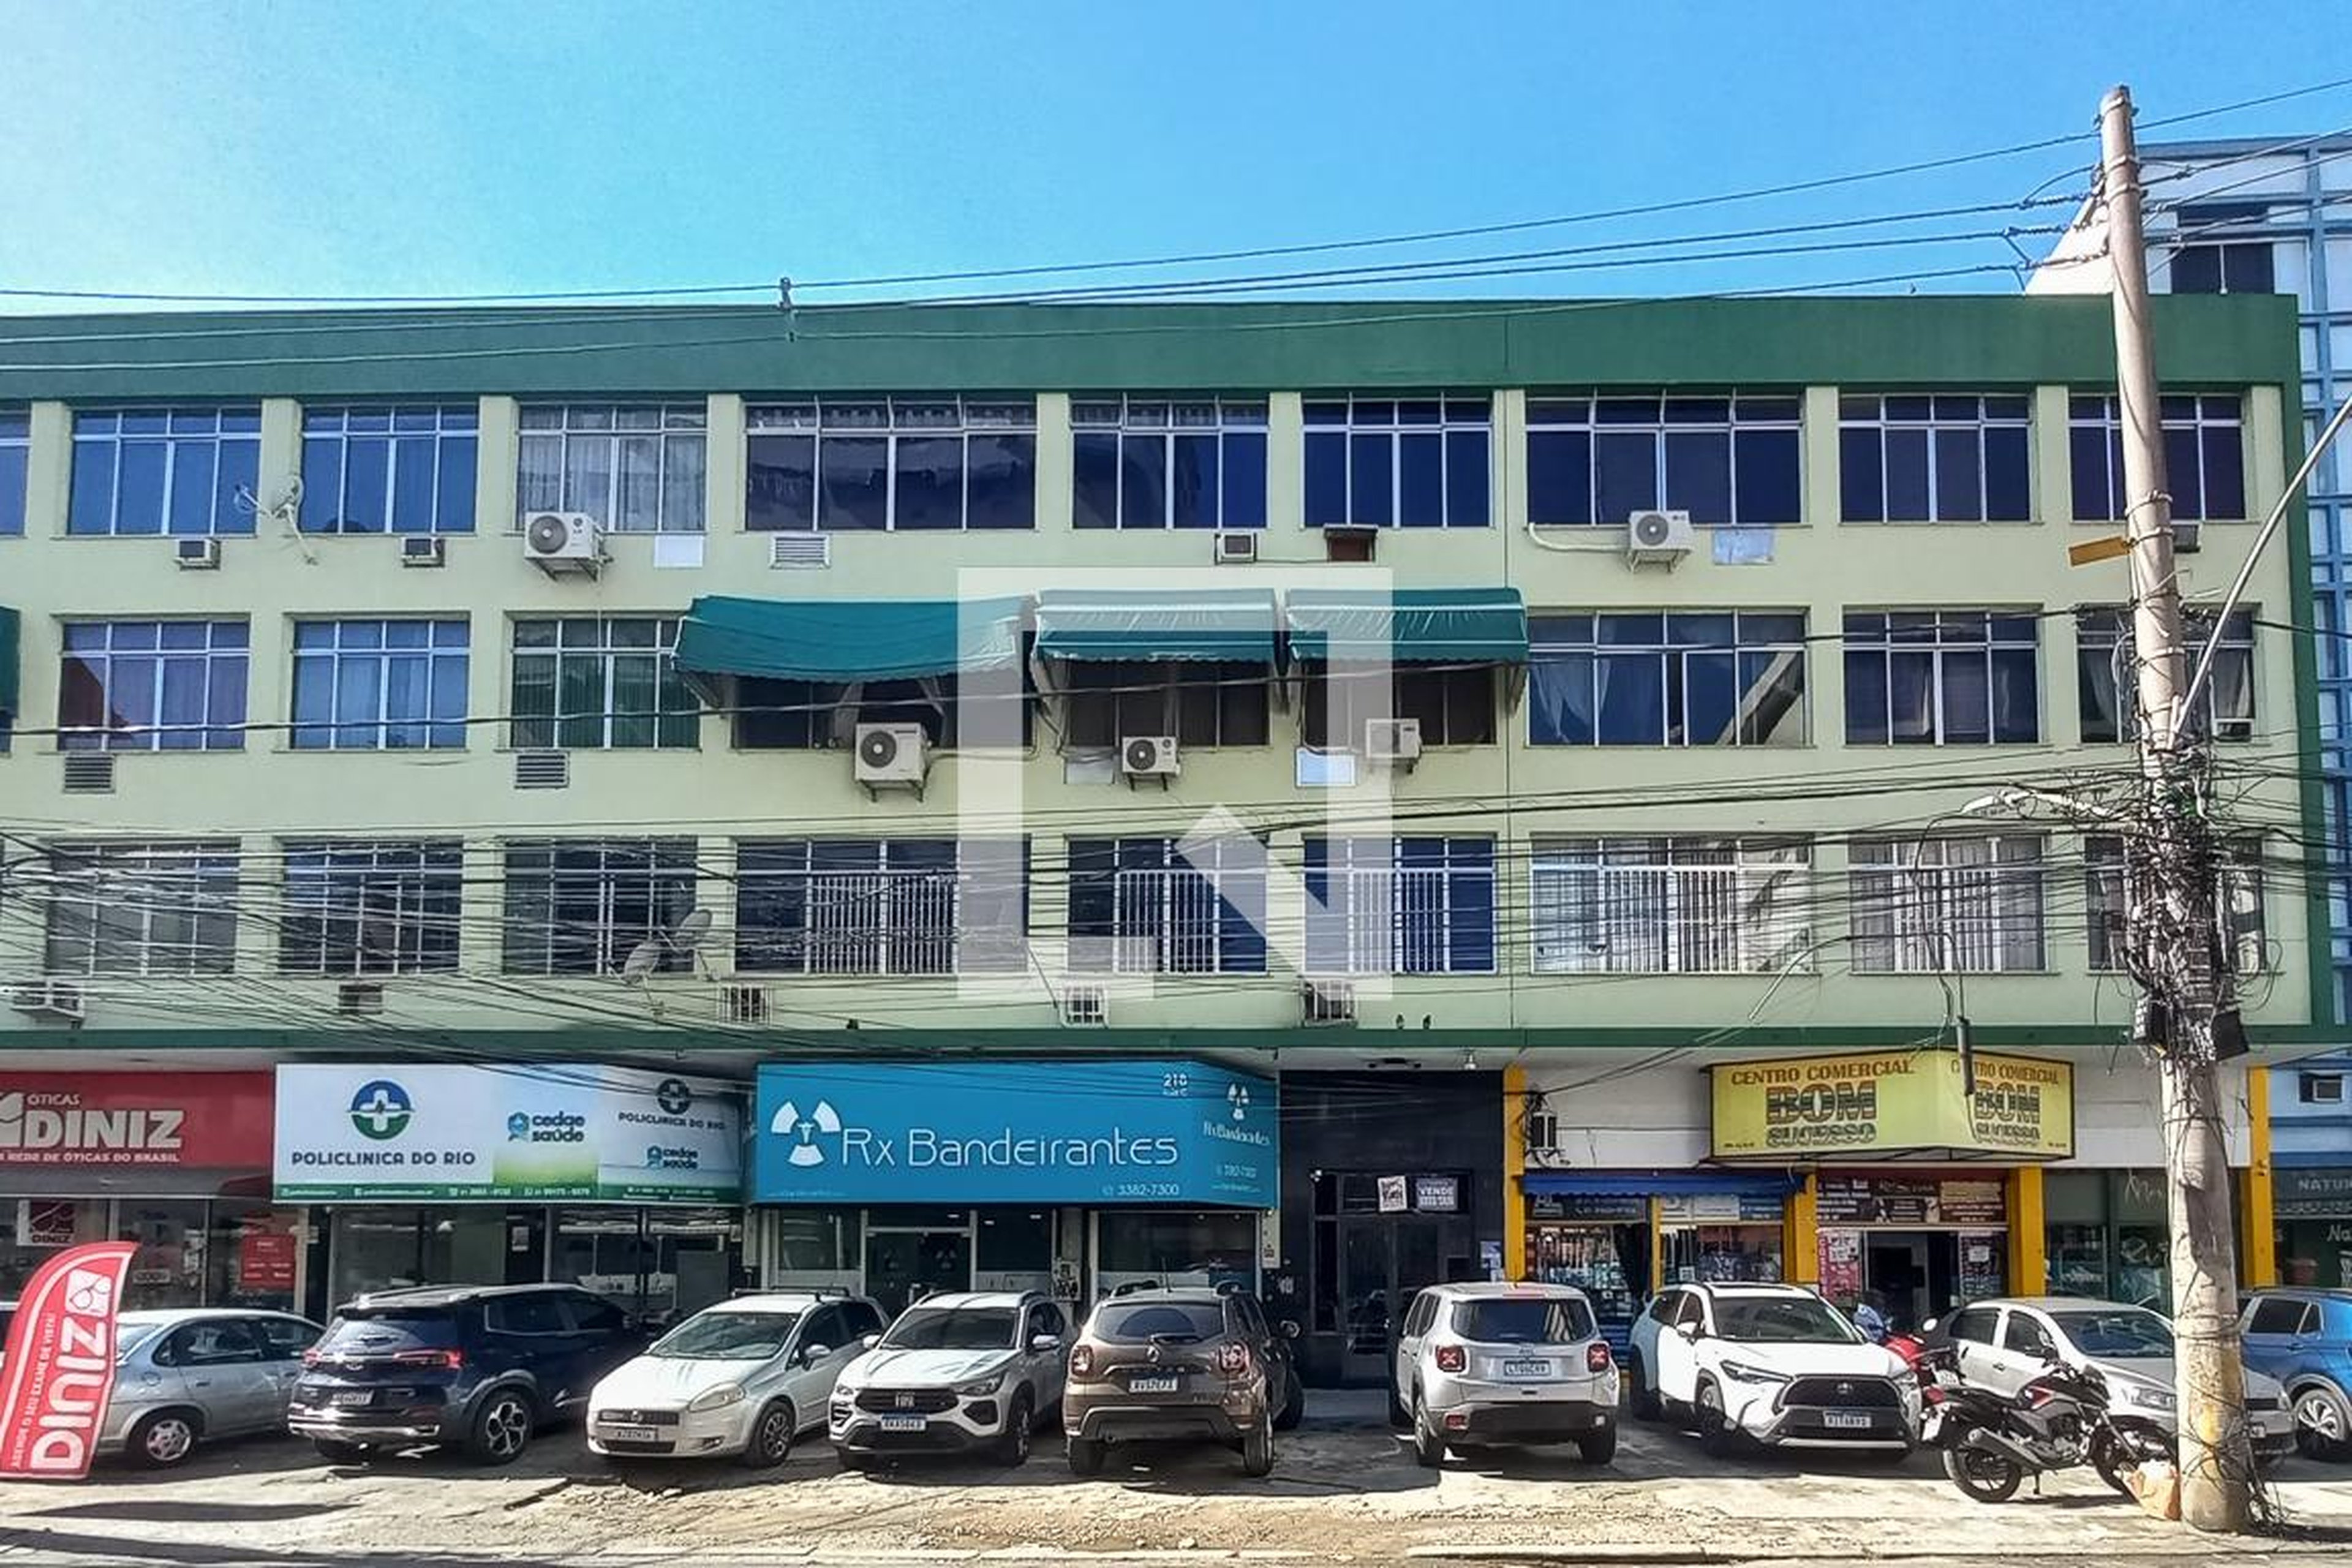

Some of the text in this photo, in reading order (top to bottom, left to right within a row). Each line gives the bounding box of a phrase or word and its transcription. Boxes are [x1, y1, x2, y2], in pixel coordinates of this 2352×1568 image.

[1732, 1059, 1914, 1085] CENTRO COMERCIAL
[1766, 1080, 1877, 1125] BOM
[1974, 1079, 2040, 1125] BOM
[24, 1110, 184, 1148] DINIZ
[1766, 1123, 1877, 1148] SUCESSO
[134, 1152, 180, 1163] BRASIL
[292, 1152, 477, 1165] POLICLINICA DO RIO
[842, 1127, 1178, 1166] Rx Bandeirantes
